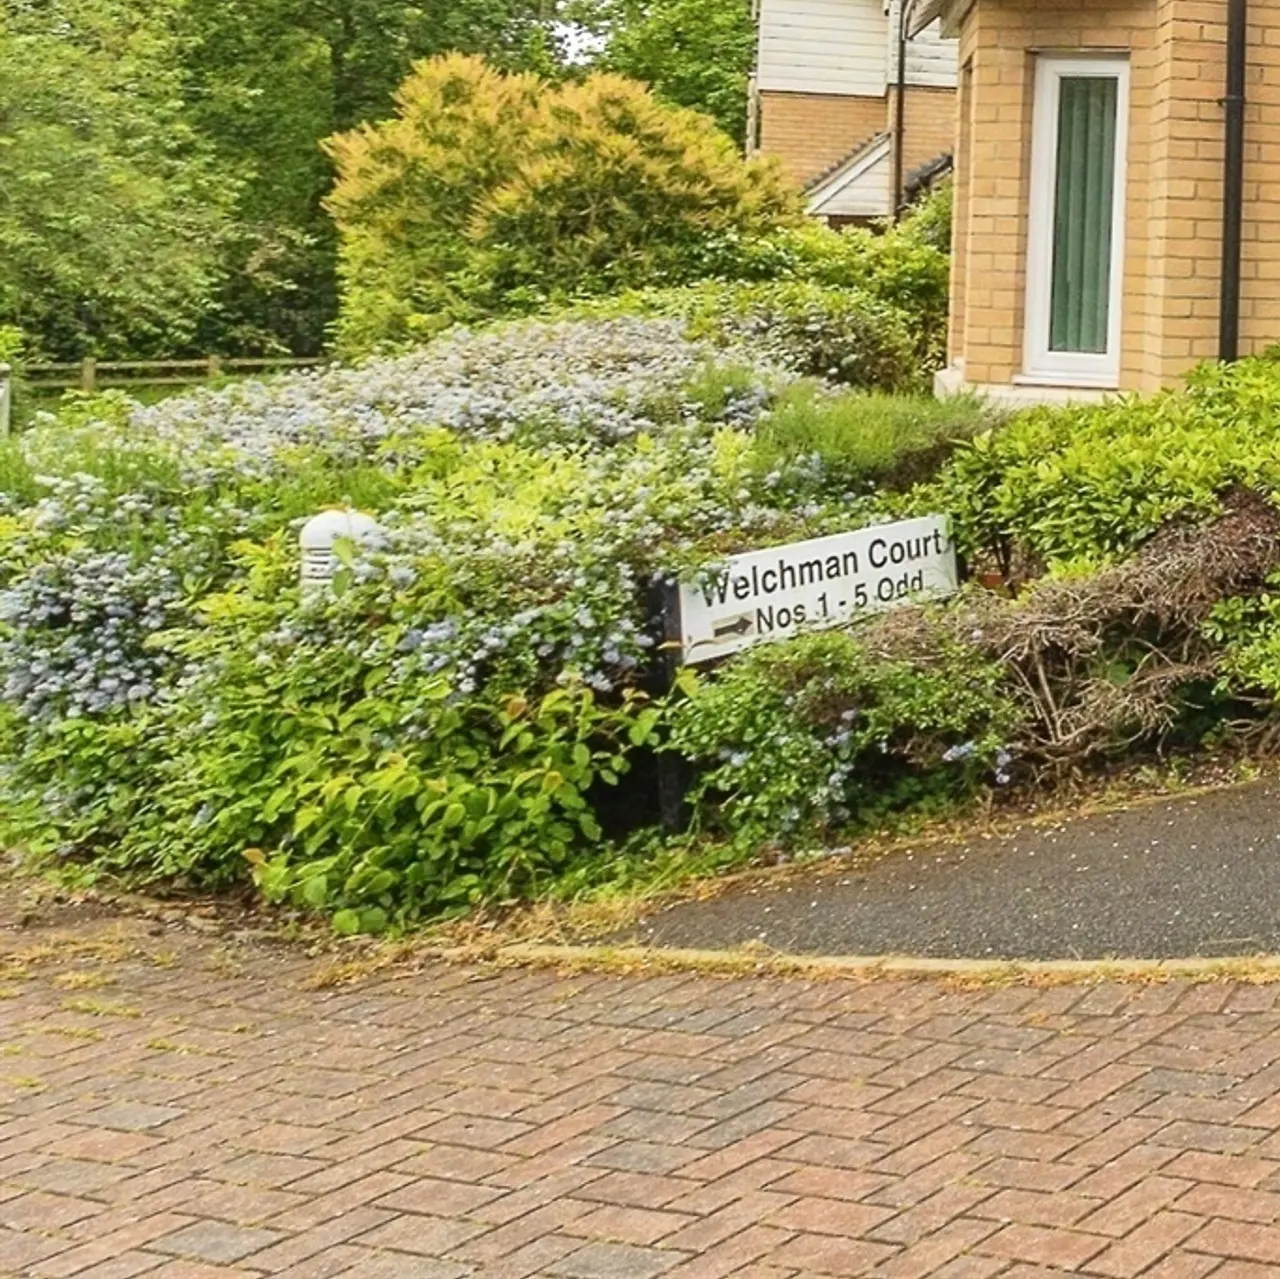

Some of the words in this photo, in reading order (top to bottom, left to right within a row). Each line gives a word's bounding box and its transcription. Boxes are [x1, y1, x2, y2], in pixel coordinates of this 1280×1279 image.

[868, 528, 943, 569] Court
[756, 604, 806, 634] Nos
[817, 592, 828, 617] 1
[854, 582, 868, 609] 5
[877, 569, 923, 602] Odd
